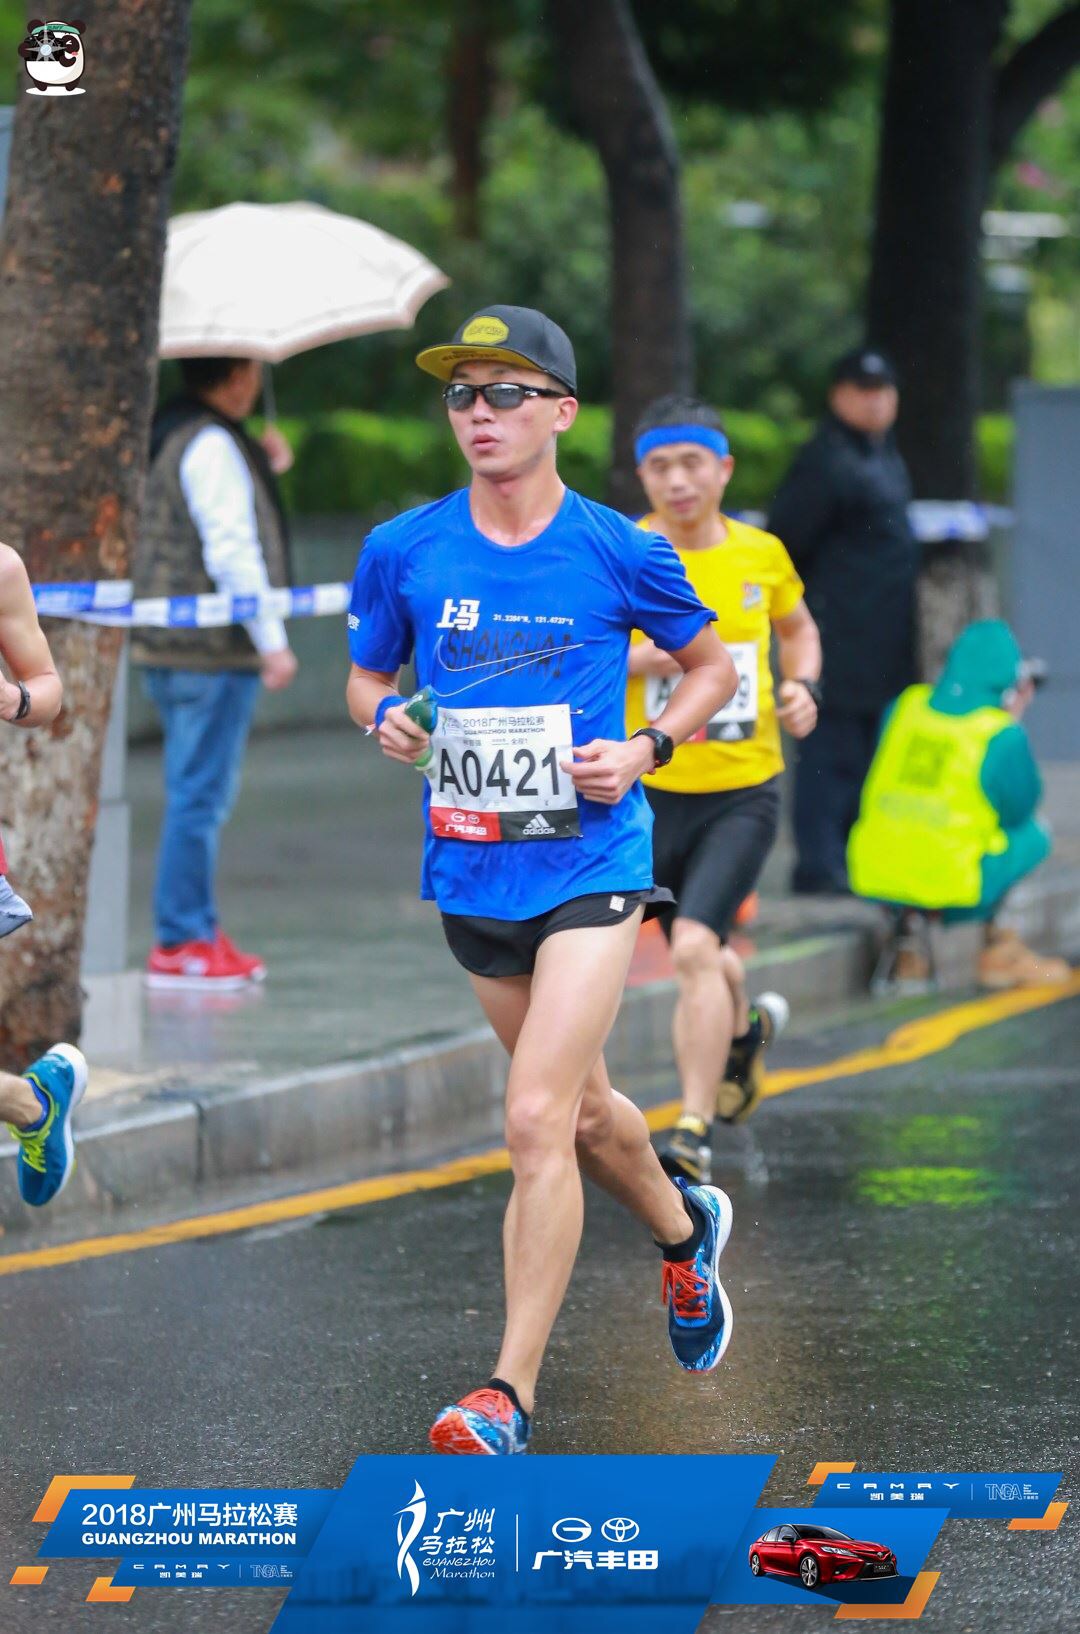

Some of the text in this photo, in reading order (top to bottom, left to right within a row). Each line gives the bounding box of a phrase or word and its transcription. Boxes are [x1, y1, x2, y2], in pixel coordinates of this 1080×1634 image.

[463, 716, 545, 728] 2018广州马拉松赛
[439, 747, 560, 798] A0421
[522, 826, 556, 835] adidas
